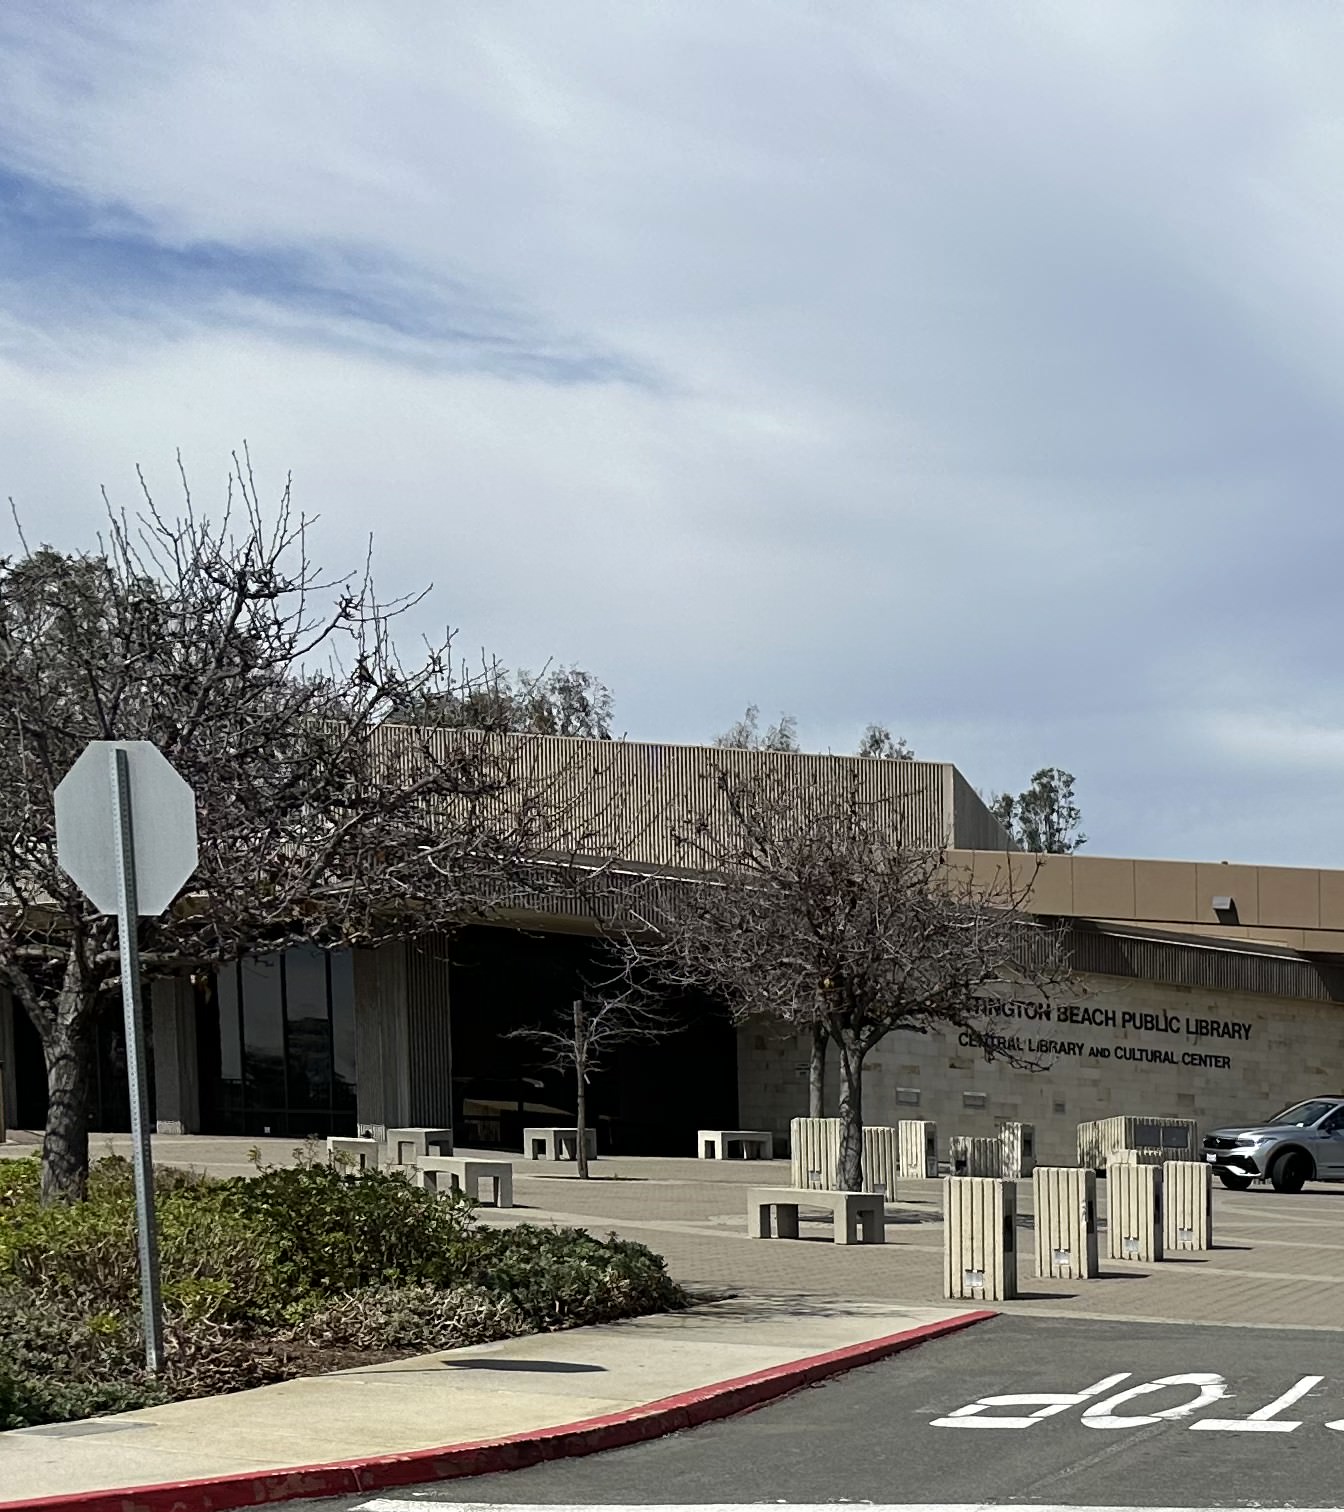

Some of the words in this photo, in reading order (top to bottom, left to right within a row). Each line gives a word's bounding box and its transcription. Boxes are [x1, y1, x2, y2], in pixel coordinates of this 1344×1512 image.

[962, 999, 1050, 1021] TINGTON
[1057, 1006, 1116, 1027] BEACH
[1122, 1011, 1180, 1033] PUBLIC
[1186, 1018, 1252, 1040] LIBRARY
[1028, 1038, 1084, 1056] LIBRARY
[1088, 1046, 1110, 1059] AND
[1114, 1046, 1178, 1064] CULTURAL
[1182, 1052, 1231, 1069] CENTER
